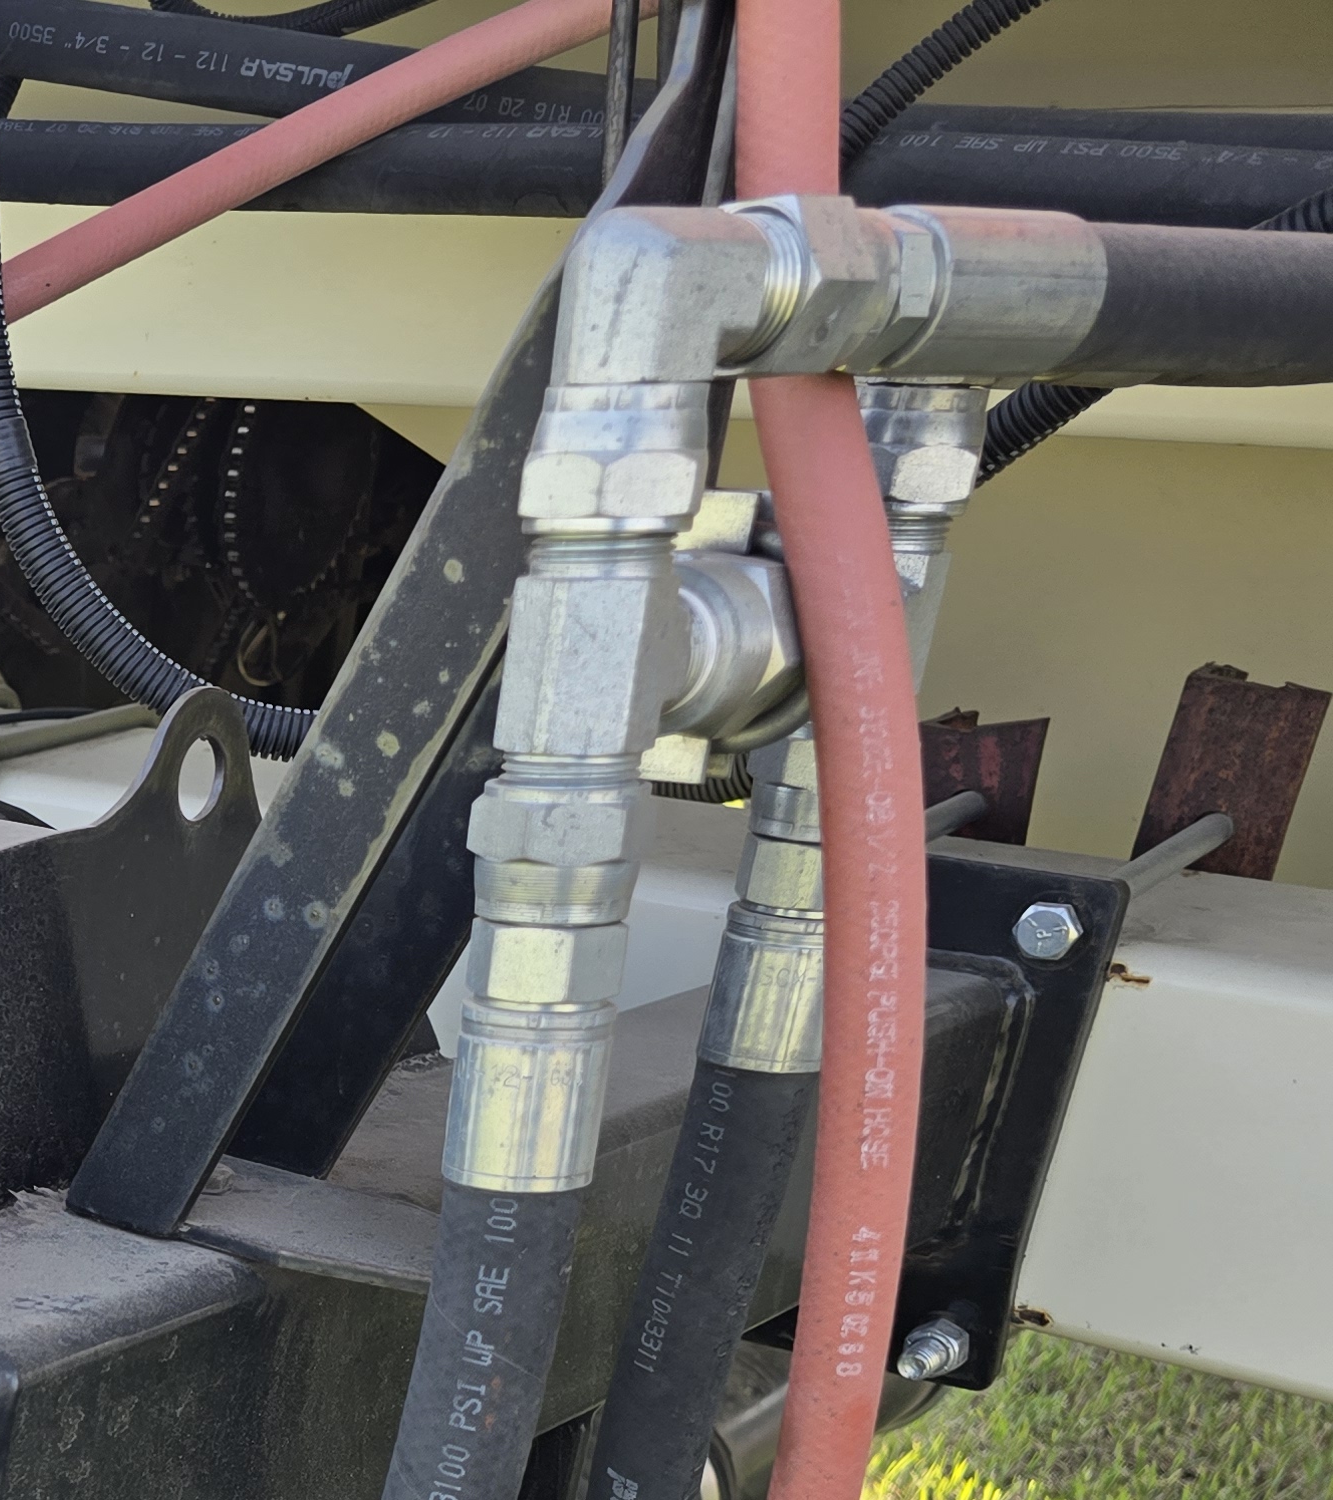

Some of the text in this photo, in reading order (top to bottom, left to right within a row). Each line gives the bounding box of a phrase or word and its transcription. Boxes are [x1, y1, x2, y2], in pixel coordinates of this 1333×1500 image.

[8, 22, 56, 45] 3500
[140, 43, 164, 62] 12
[196, 51, 228, 72] 112
[240, 57, 353, 90] PULSAR
[462, 94, 604, 125] 00 R16 2Q 07
[427, 126, 455, 139] 12
[482, 126, 519, 138] 112
[953, 136, 1005, 150] SAE
[1013, 139, 1047, 154] WP
[1060, 141, 1110, 155] PSI
[1119, 145, 1187, 161] 3500
[707, 1068, 736, 1113] 100
[691, 1122, 725, 1173] R17
[679, 1182, 709, 1221] 3Q
[483, 1197, 519, 1245] 100
[666, 1234, 694, 1257] 11
[472, 1264, 511, 1316] SAE
[632, 1269, 682, 1374] T1043311
[461, 1329, 495, 1366] WP
[448, 1379, 487, 1432] PSI
